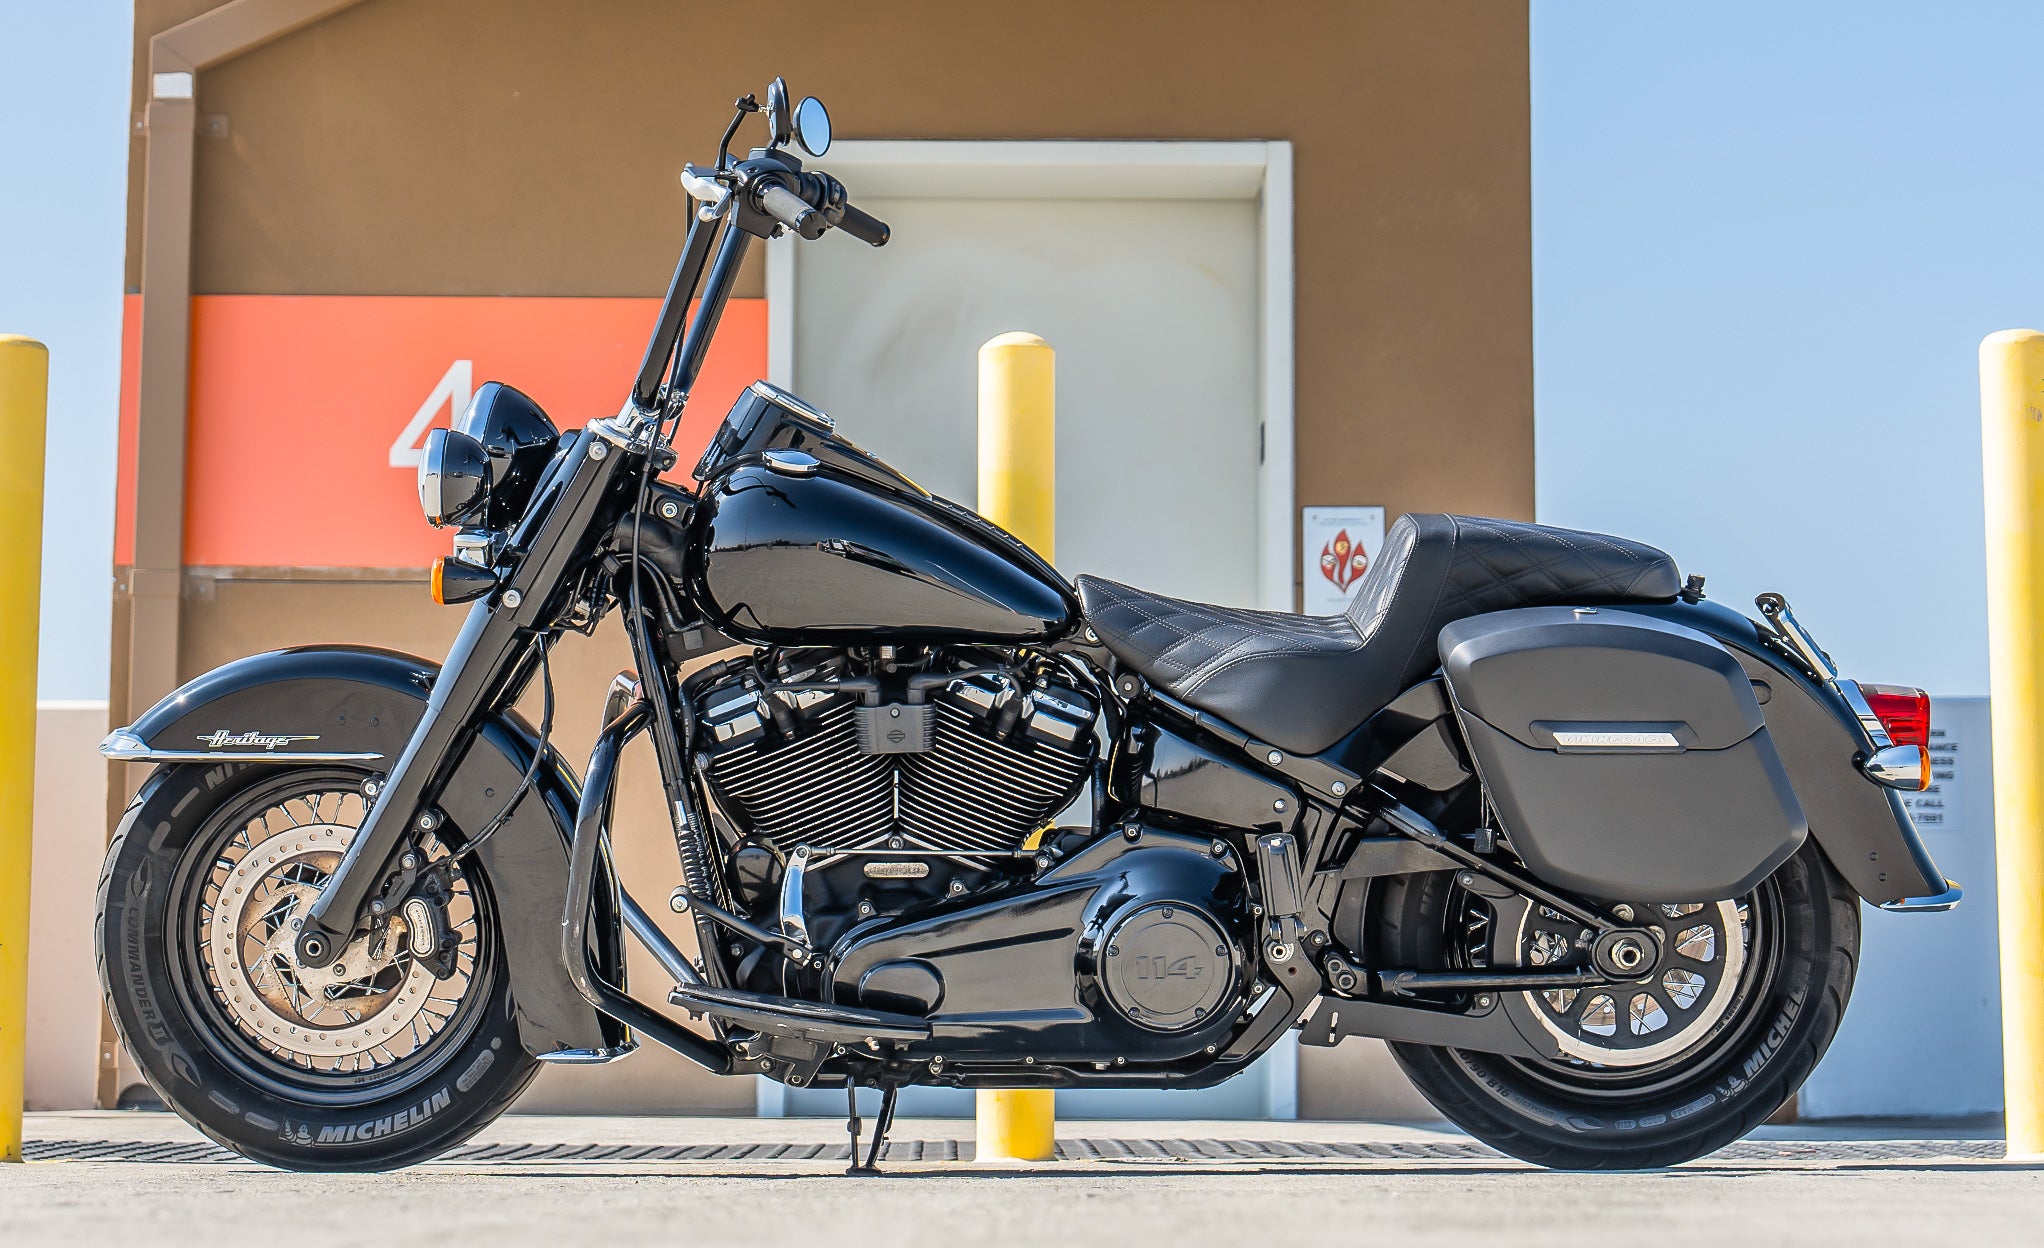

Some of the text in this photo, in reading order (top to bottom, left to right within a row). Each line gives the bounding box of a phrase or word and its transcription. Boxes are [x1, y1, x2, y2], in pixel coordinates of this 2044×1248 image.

[389, 360, 472, 467] 4
[207, 729, 289, 750] Heritage
[126, 906, 157, 1023] COMMANDER
[1136, 955, 1204, 980] 114
[1743, 957, 1811, 1078] MICHEL
[317, 1087, 451, 1142] MICHELIN
